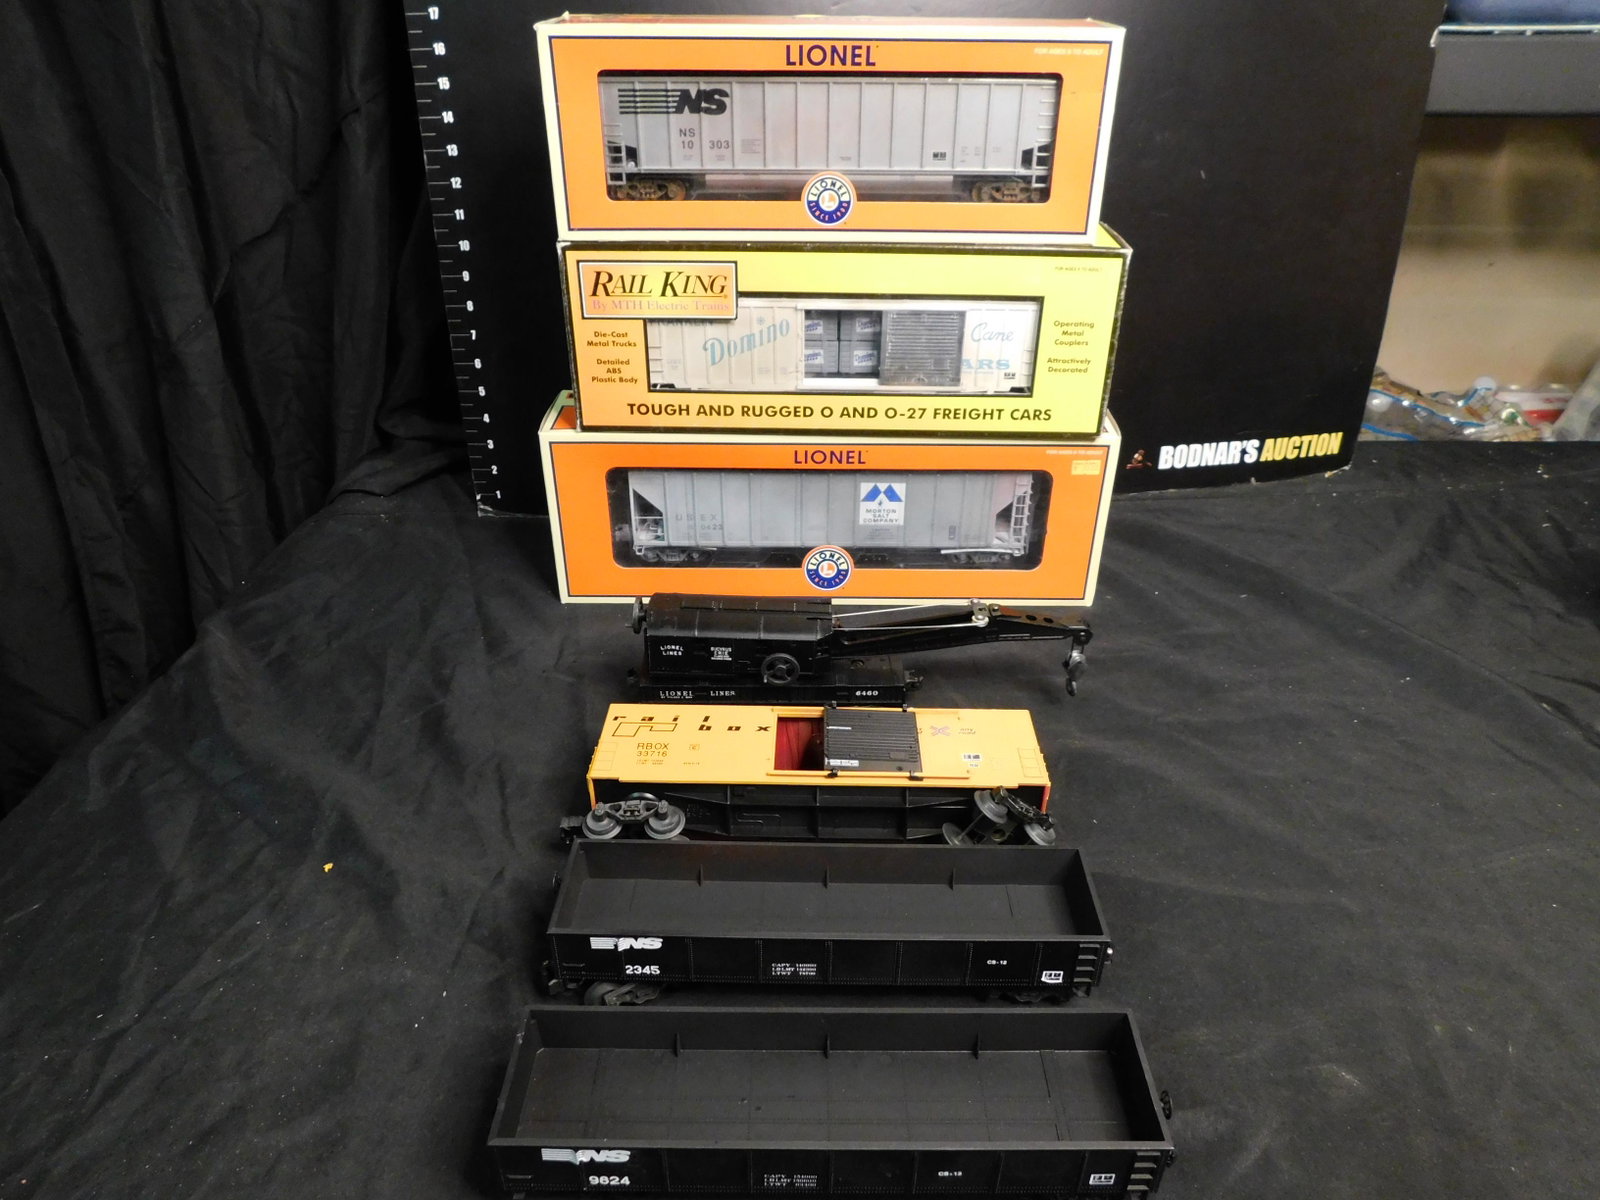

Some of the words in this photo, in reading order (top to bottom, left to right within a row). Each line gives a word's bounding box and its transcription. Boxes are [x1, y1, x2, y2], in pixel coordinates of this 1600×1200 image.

[428, 7, 439, 20] 17
[433, 42, 446, 55] 16
[785, 44, 876, 67] LIONEL
[437, 77, 450, 90] 15
[442, 111, 454, 123] 14
[679, 127, 696, 138] NS
[446, 144, 458, 156] 13
[451, 177, 462, 189] 12
[810, 180, 848, 197] LIONEL
[454, 209, 465, 220] 11
[458, 240, 470, 252] 10
[462, 270, 470, 282] 9
[590, 271, 652, 297] RAIL
[659, 271, 728, 297] KING
[466, 300, 474, 312] 8
[592, 300, 608, 311] By
[611, 300, 643, 310] MTH
[647, 300, 689, 311] Electric
[694, 301, 730, 311] Trains
[1053, 320, 1095, 328] Operating
[470, 330, 477, 340] 7
[971, 322, 1014, 342] Cane
[703, 317, 790, 366] Domino
[474, 358, 482, 369] 6
[1047, 357, 1091, 365] Attractively
[478, 386, 486, 397] 5
[483, 413, 490, 423] 4
[627, 403, 690, 416] TOUGH
[696, 404, 734, 417] AND
[741, 405, 814, 418] RUGGED
[821, 406, 834, 418] O
[839, 406, 878, 419] AND
[884, 407, 927, 420] O-27
[933, 408, 1005, 420] FREIGHT
[1010, 408, 1052, 421] CARS
[487, 439, 494, 449] 3
[1158, 439, 1261, 470] BODNAR'S
[1259, 431, 1343, 462] AUCTION
[794, 450, 866, 464] LIONEL
[491, 465, 498, 474] 2
[495, 490, 501, 500] 1
[810, 552, 846, 566] LIONEL
[625, 965, 661, 975] 2345
